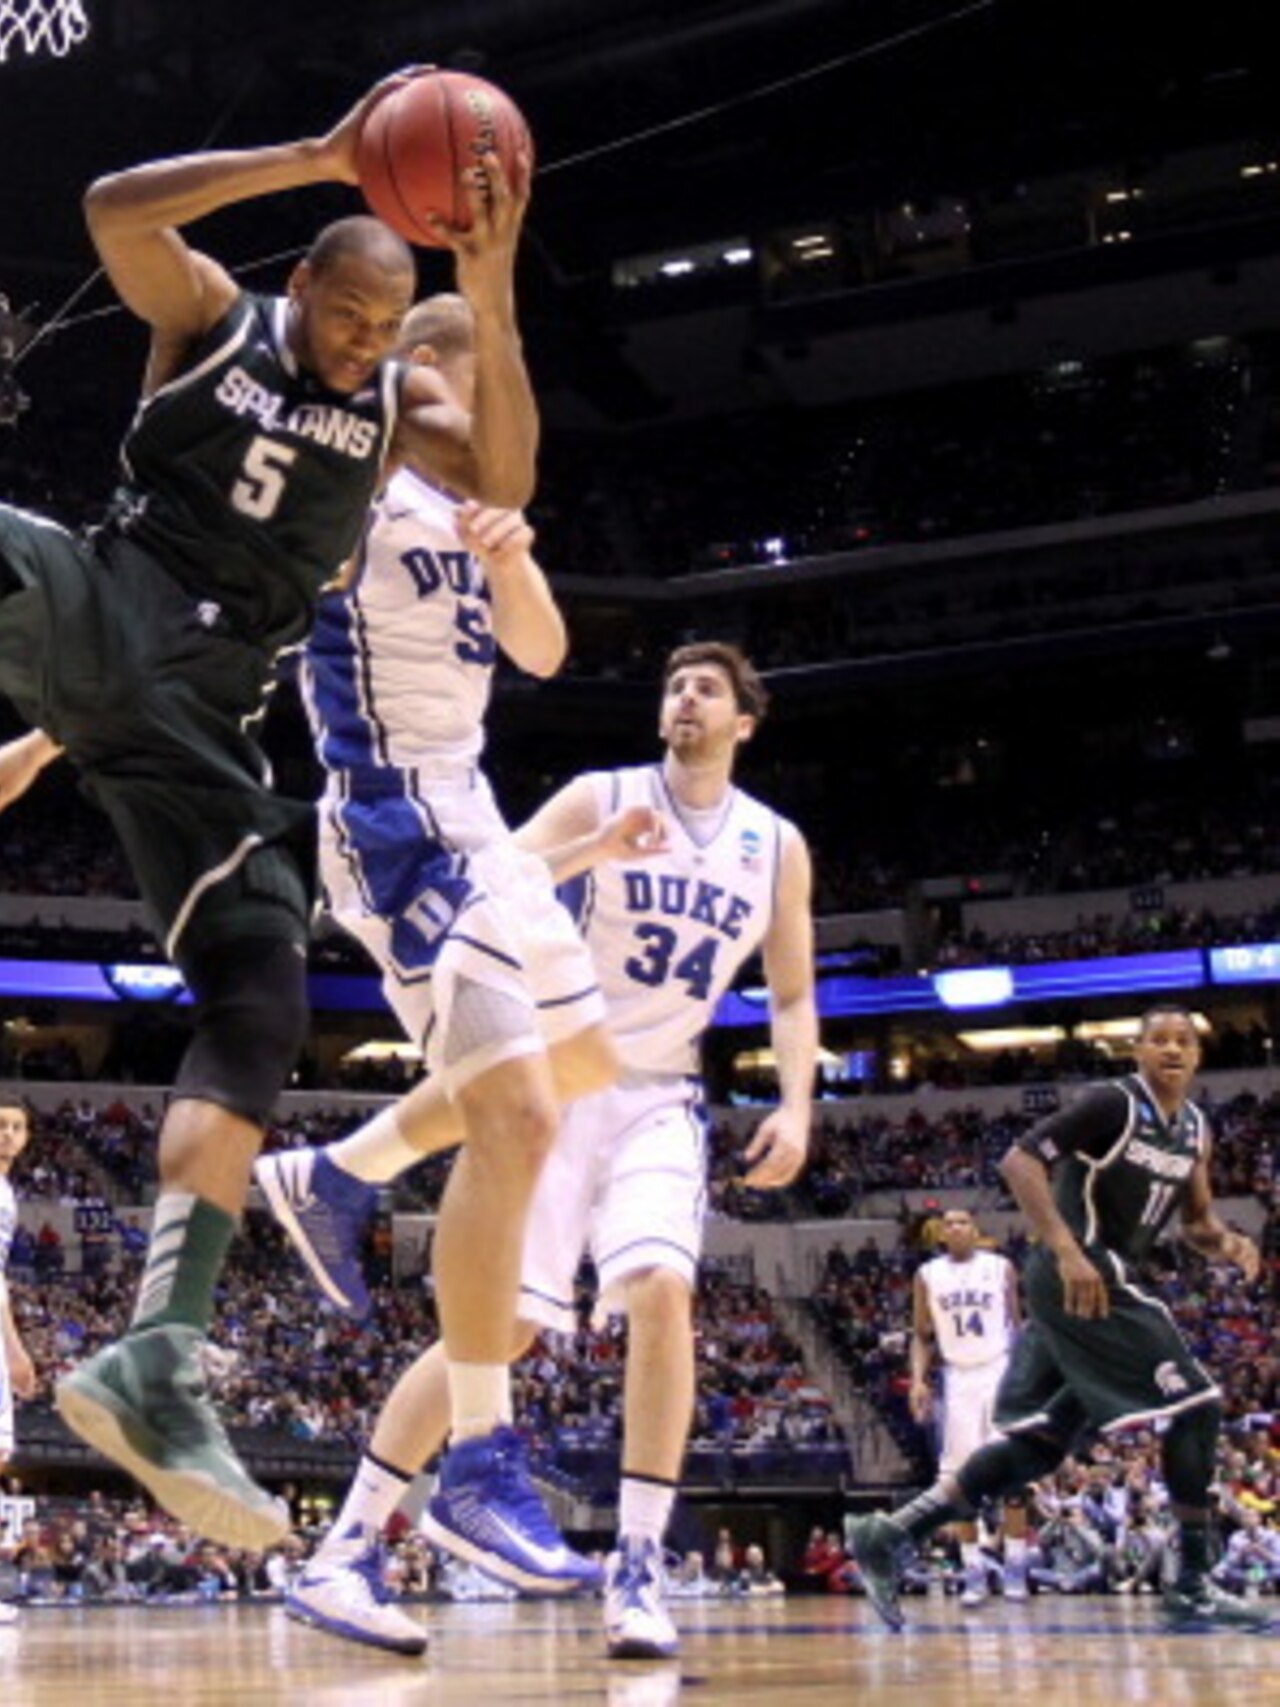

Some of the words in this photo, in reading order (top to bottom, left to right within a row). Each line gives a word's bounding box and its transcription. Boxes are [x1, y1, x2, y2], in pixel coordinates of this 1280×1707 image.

[215, 365, 379, 459] SPATANS
[231, 435, 297, 521] 5
[623, 869, 754, 941] DUKE
[625, 922, 719, 1001] 34
[952, 1310, 984, 1337] 14
